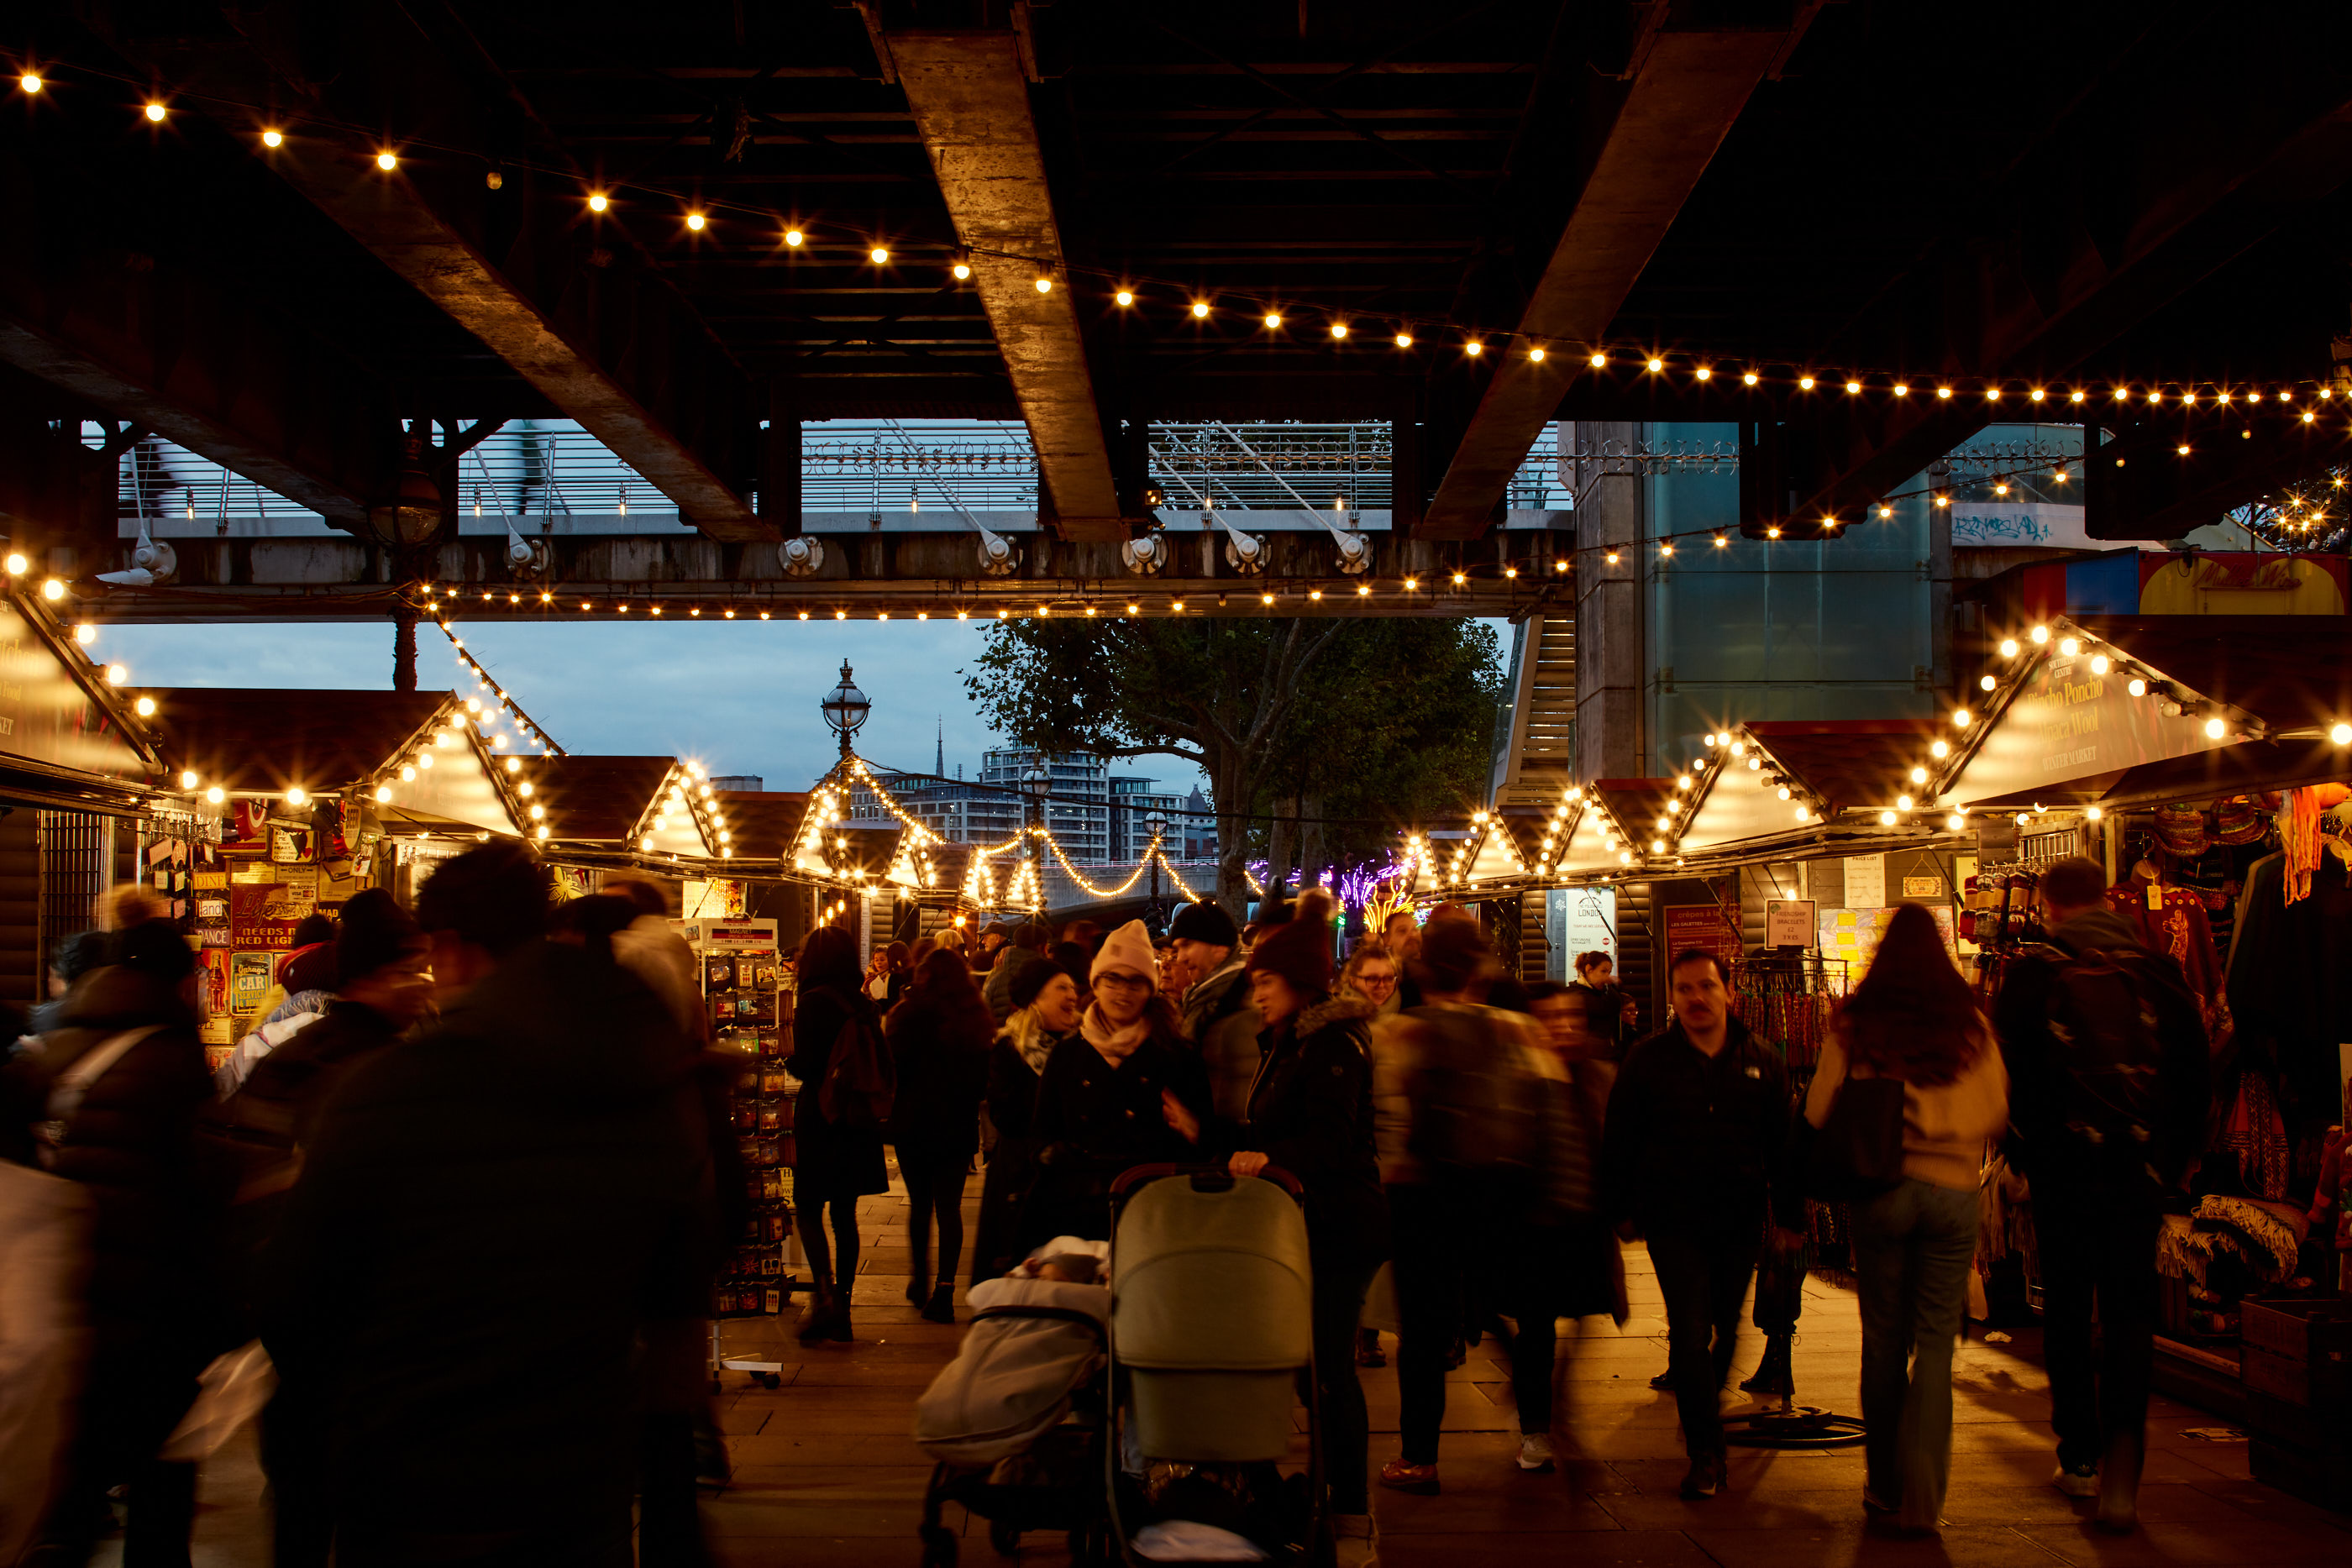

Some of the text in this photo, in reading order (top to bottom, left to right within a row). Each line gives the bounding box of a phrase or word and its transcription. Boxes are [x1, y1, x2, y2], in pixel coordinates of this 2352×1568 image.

[2064, 674, 2103, 706] Poncho
[2071, 705, 2099, 737] Wool
[2068, 746, 2097, 767] MARKET
[196, 874, 225, 888] DINE
[235, 893, 276, 928] Life
[198, 931, 228, 945] DANCE
[242, 927, 284, 936] NEEDS
[235, 936, 262, 945] RED
[238, 976, 265, 991] CAR
